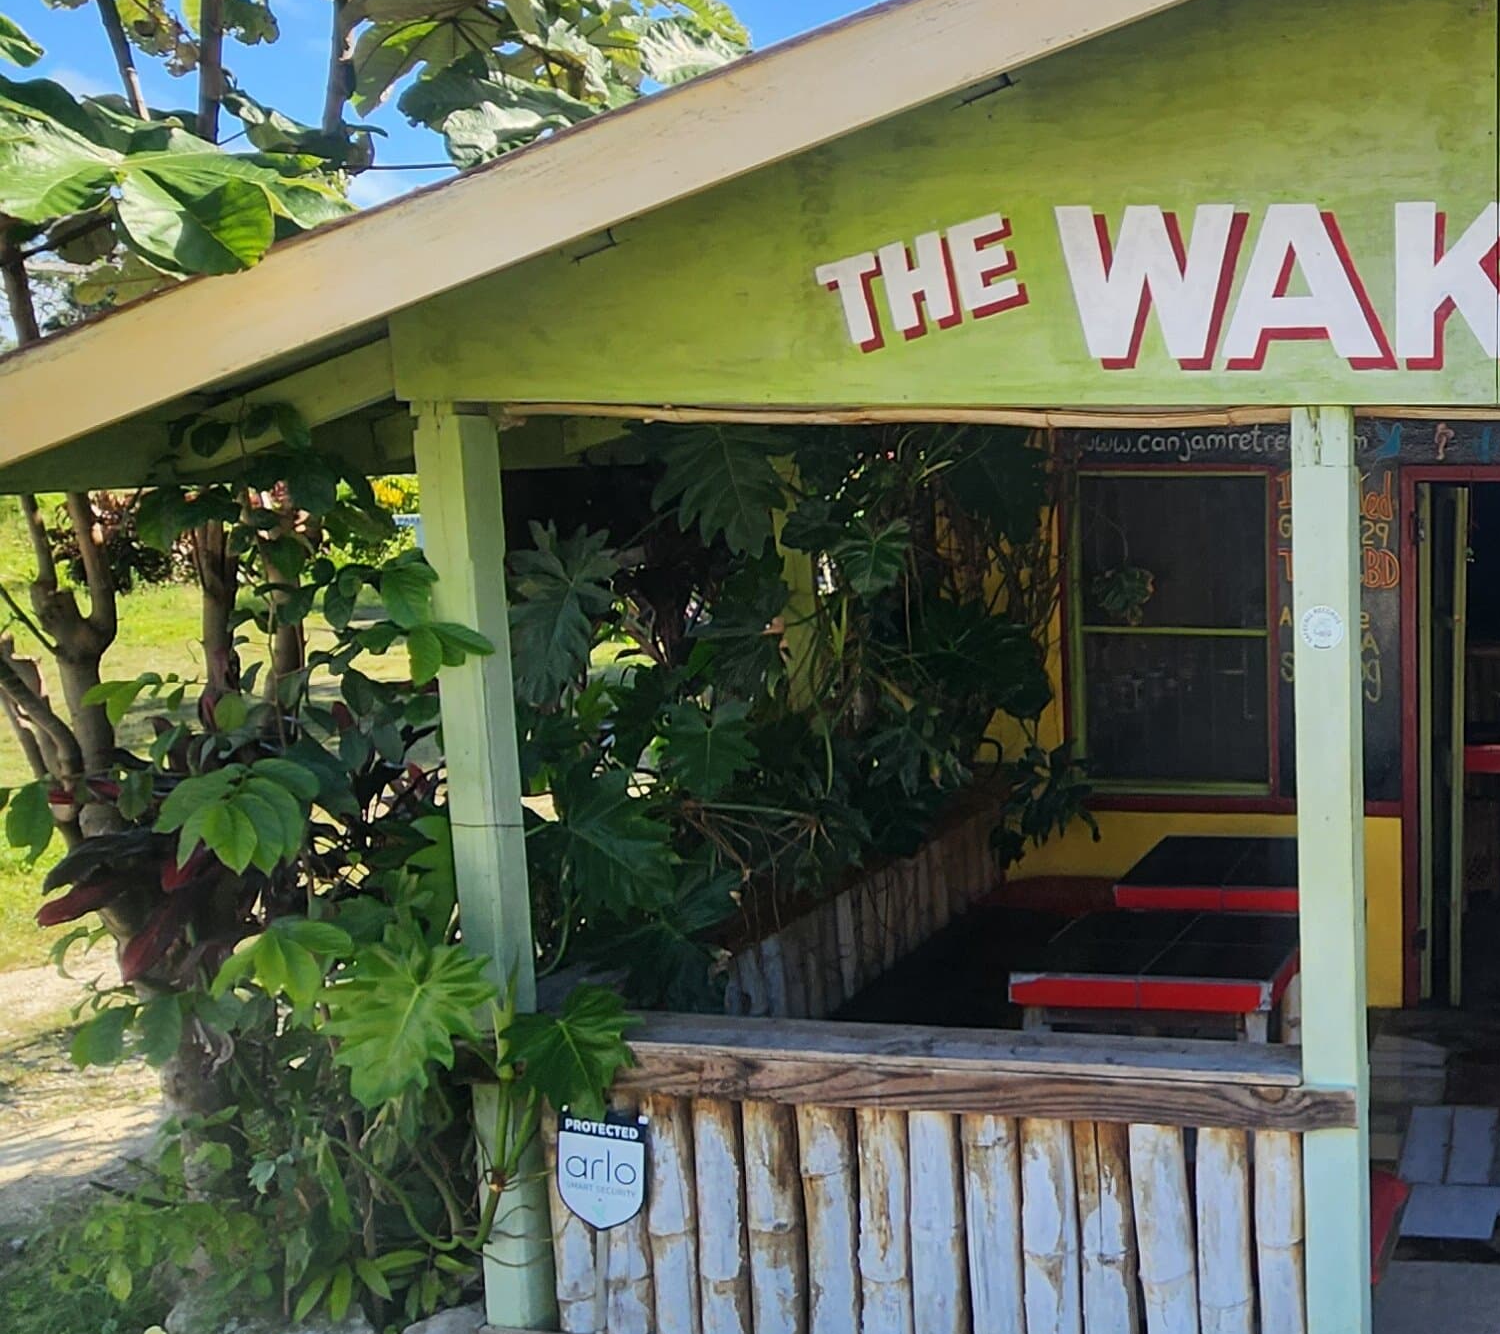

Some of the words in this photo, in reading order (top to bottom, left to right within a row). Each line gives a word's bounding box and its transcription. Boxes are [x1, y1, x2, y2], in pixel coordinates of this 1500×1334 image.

[814, 212, 1029, 354] THE
[564, 1118, 640, 1140] PROTECTED
[565, 1149, 637, 1186] arlo
